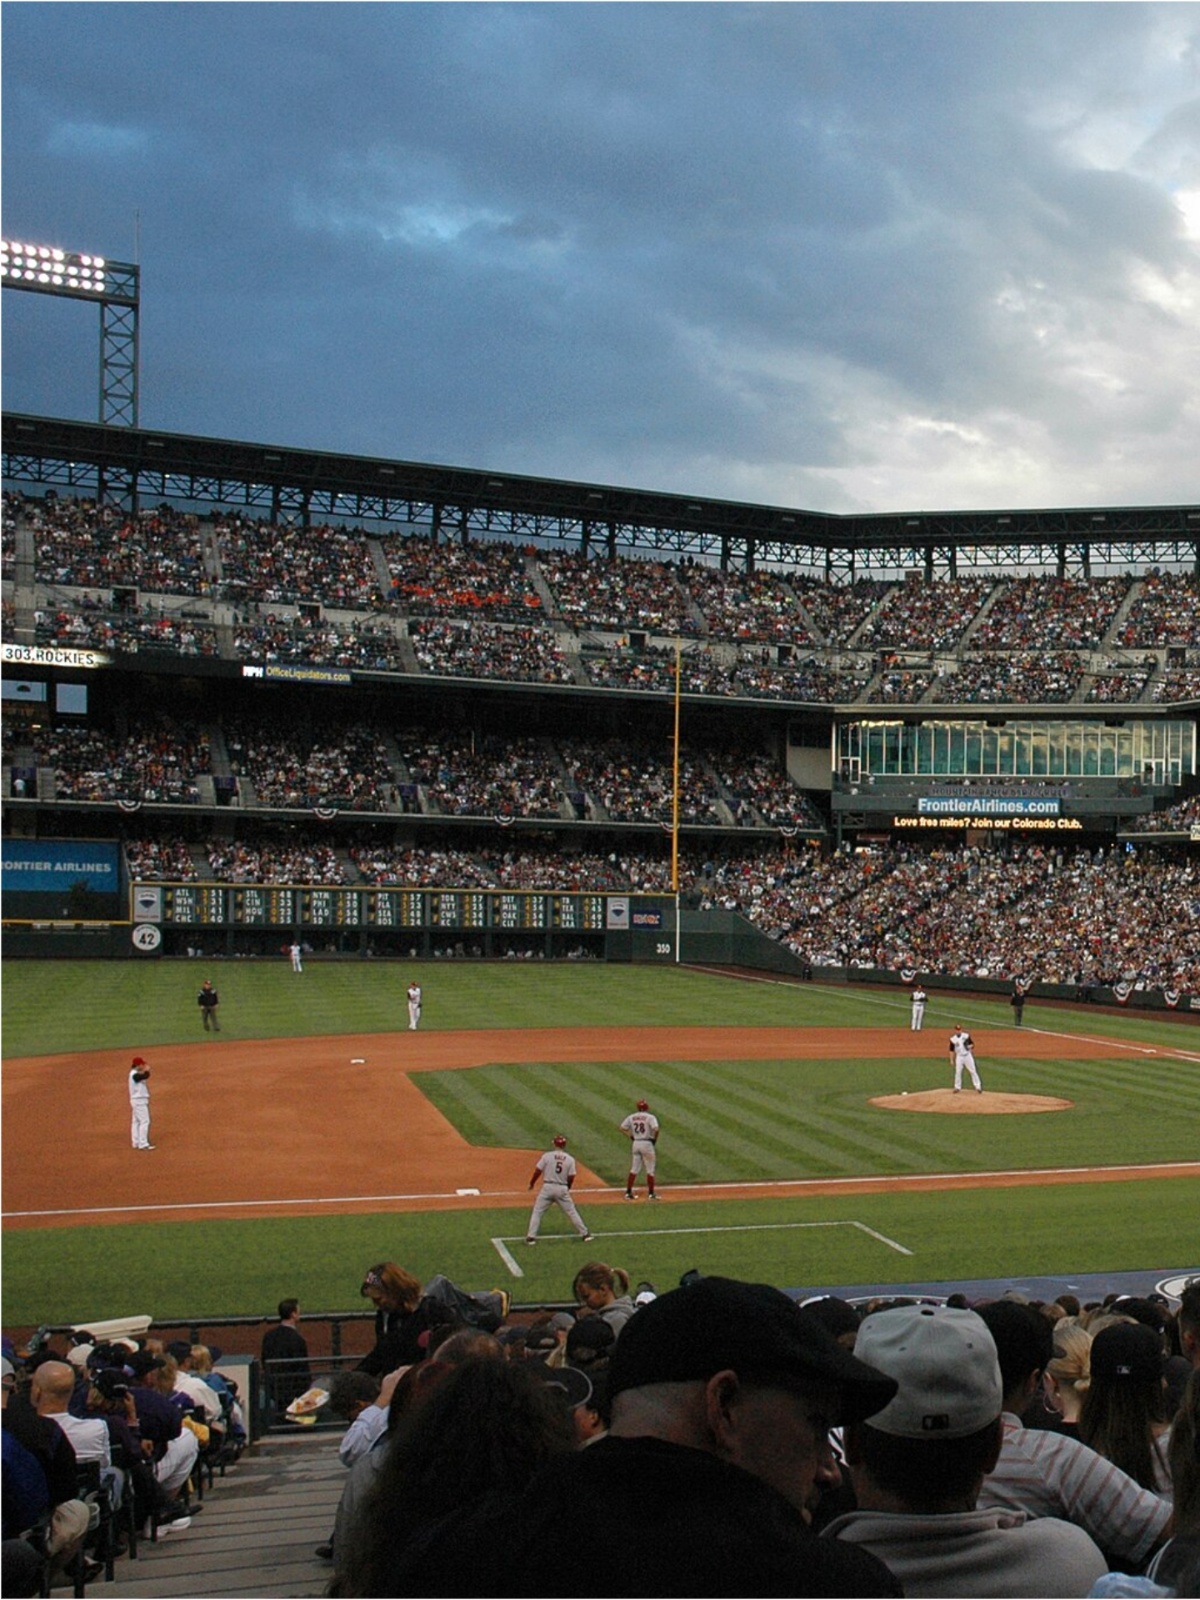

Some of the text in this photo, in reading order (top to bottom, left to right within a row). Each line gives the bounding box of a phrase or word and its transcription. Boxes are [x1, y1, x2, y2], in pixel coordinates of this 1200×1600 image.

[266, 666, 351, 682] OfficeLiquidators.com
[918, 798, 1058, 813] FrontierAirlines.com
[894, 817, 1082, 829] Love free miles? Join our Colorado Club.
[54, 862, 111, 872] AIRLINES
[139, 933, 155, 946] 42
[656, 944, 671, 954] 350
[634, 1122, 645, 1134] 28
[555, 1161, 563, 1174] 5
